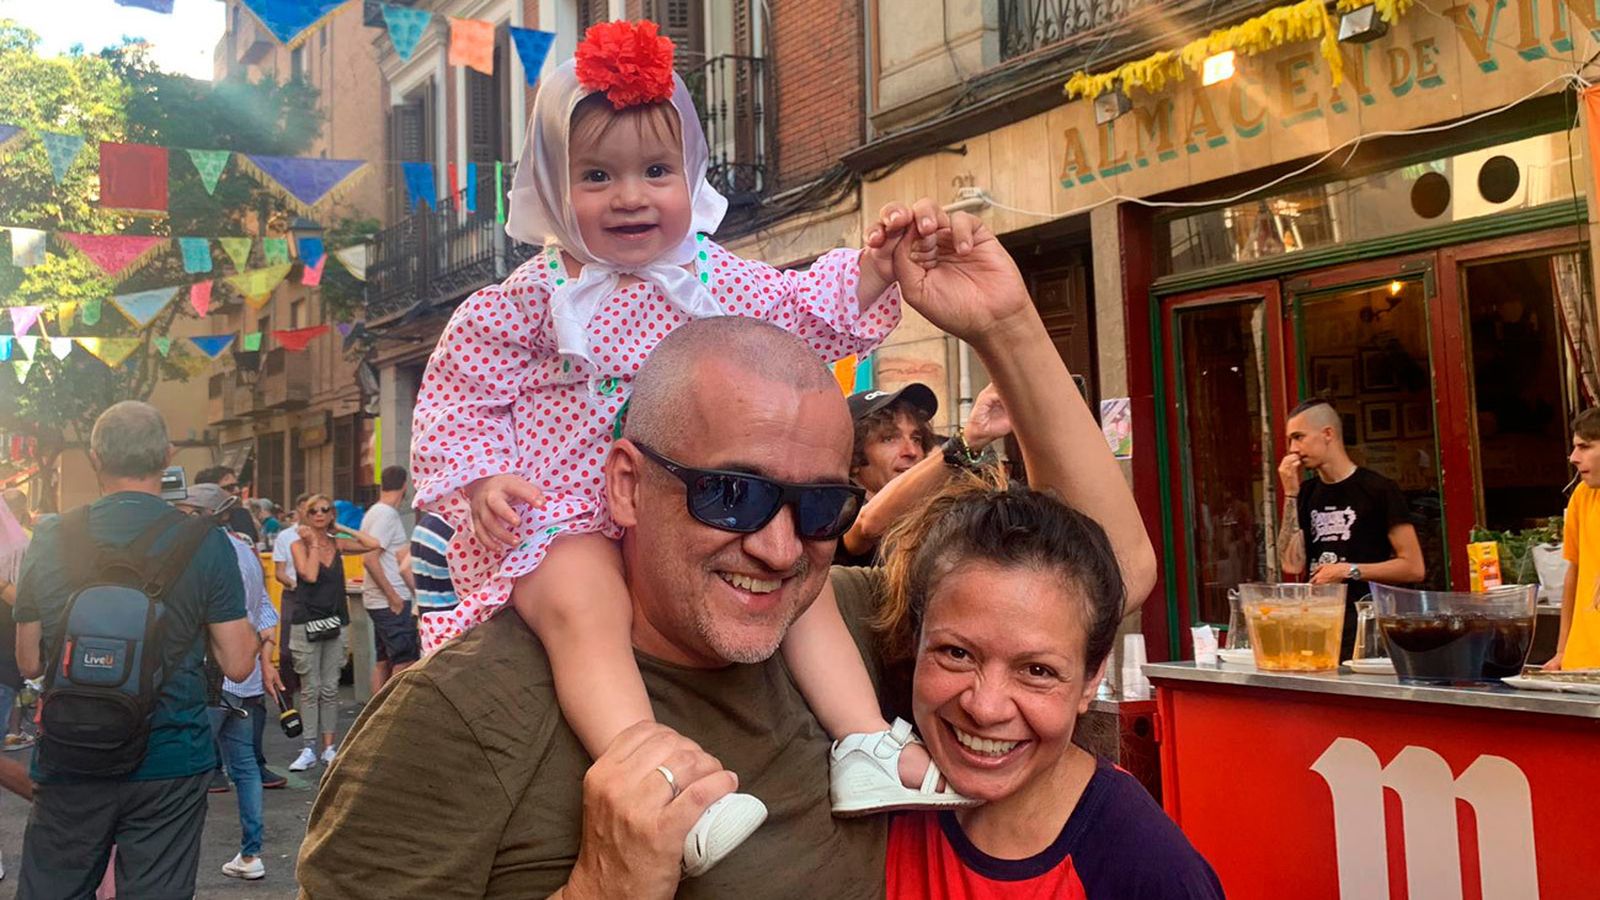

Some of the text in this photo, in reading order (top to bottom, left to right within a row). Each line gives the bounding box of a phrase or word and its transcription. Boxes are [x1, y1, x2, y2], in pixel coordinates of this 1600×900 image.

[1060, 43, 1375, 188] ALMACEN
[1387, 37, 1444, 97] DE
[84, 653, 113, 665] LiveU
